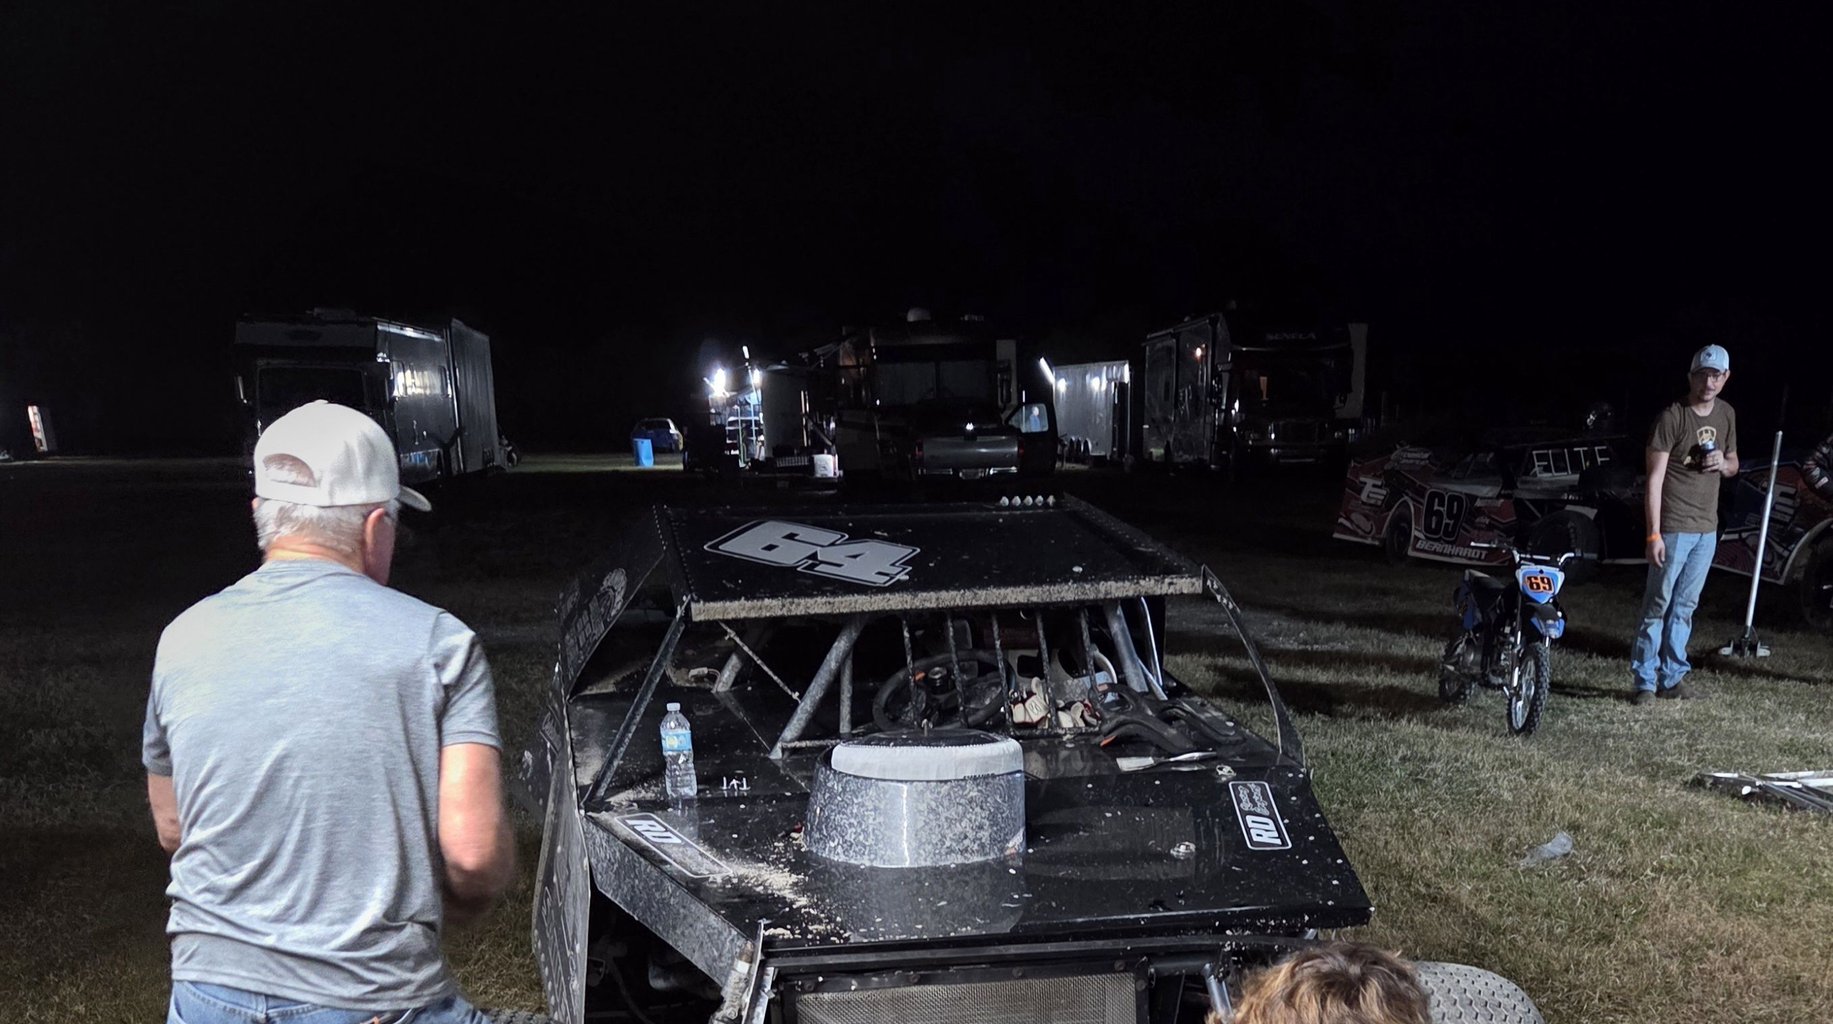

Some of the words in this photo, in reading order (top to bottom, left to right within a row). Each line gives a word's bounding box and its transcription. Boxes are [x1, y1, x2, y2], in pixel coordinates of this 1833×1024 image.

[1423, 488, 1466, 541] 69
[704, 520, 921, 587] 64
[1415, 539, 1488, 560] BERNHARDT
[1526, 575, 1554, 592] 69
[625, 820, 682, 844] RD
[1245, 815, 1282, 845] RD
